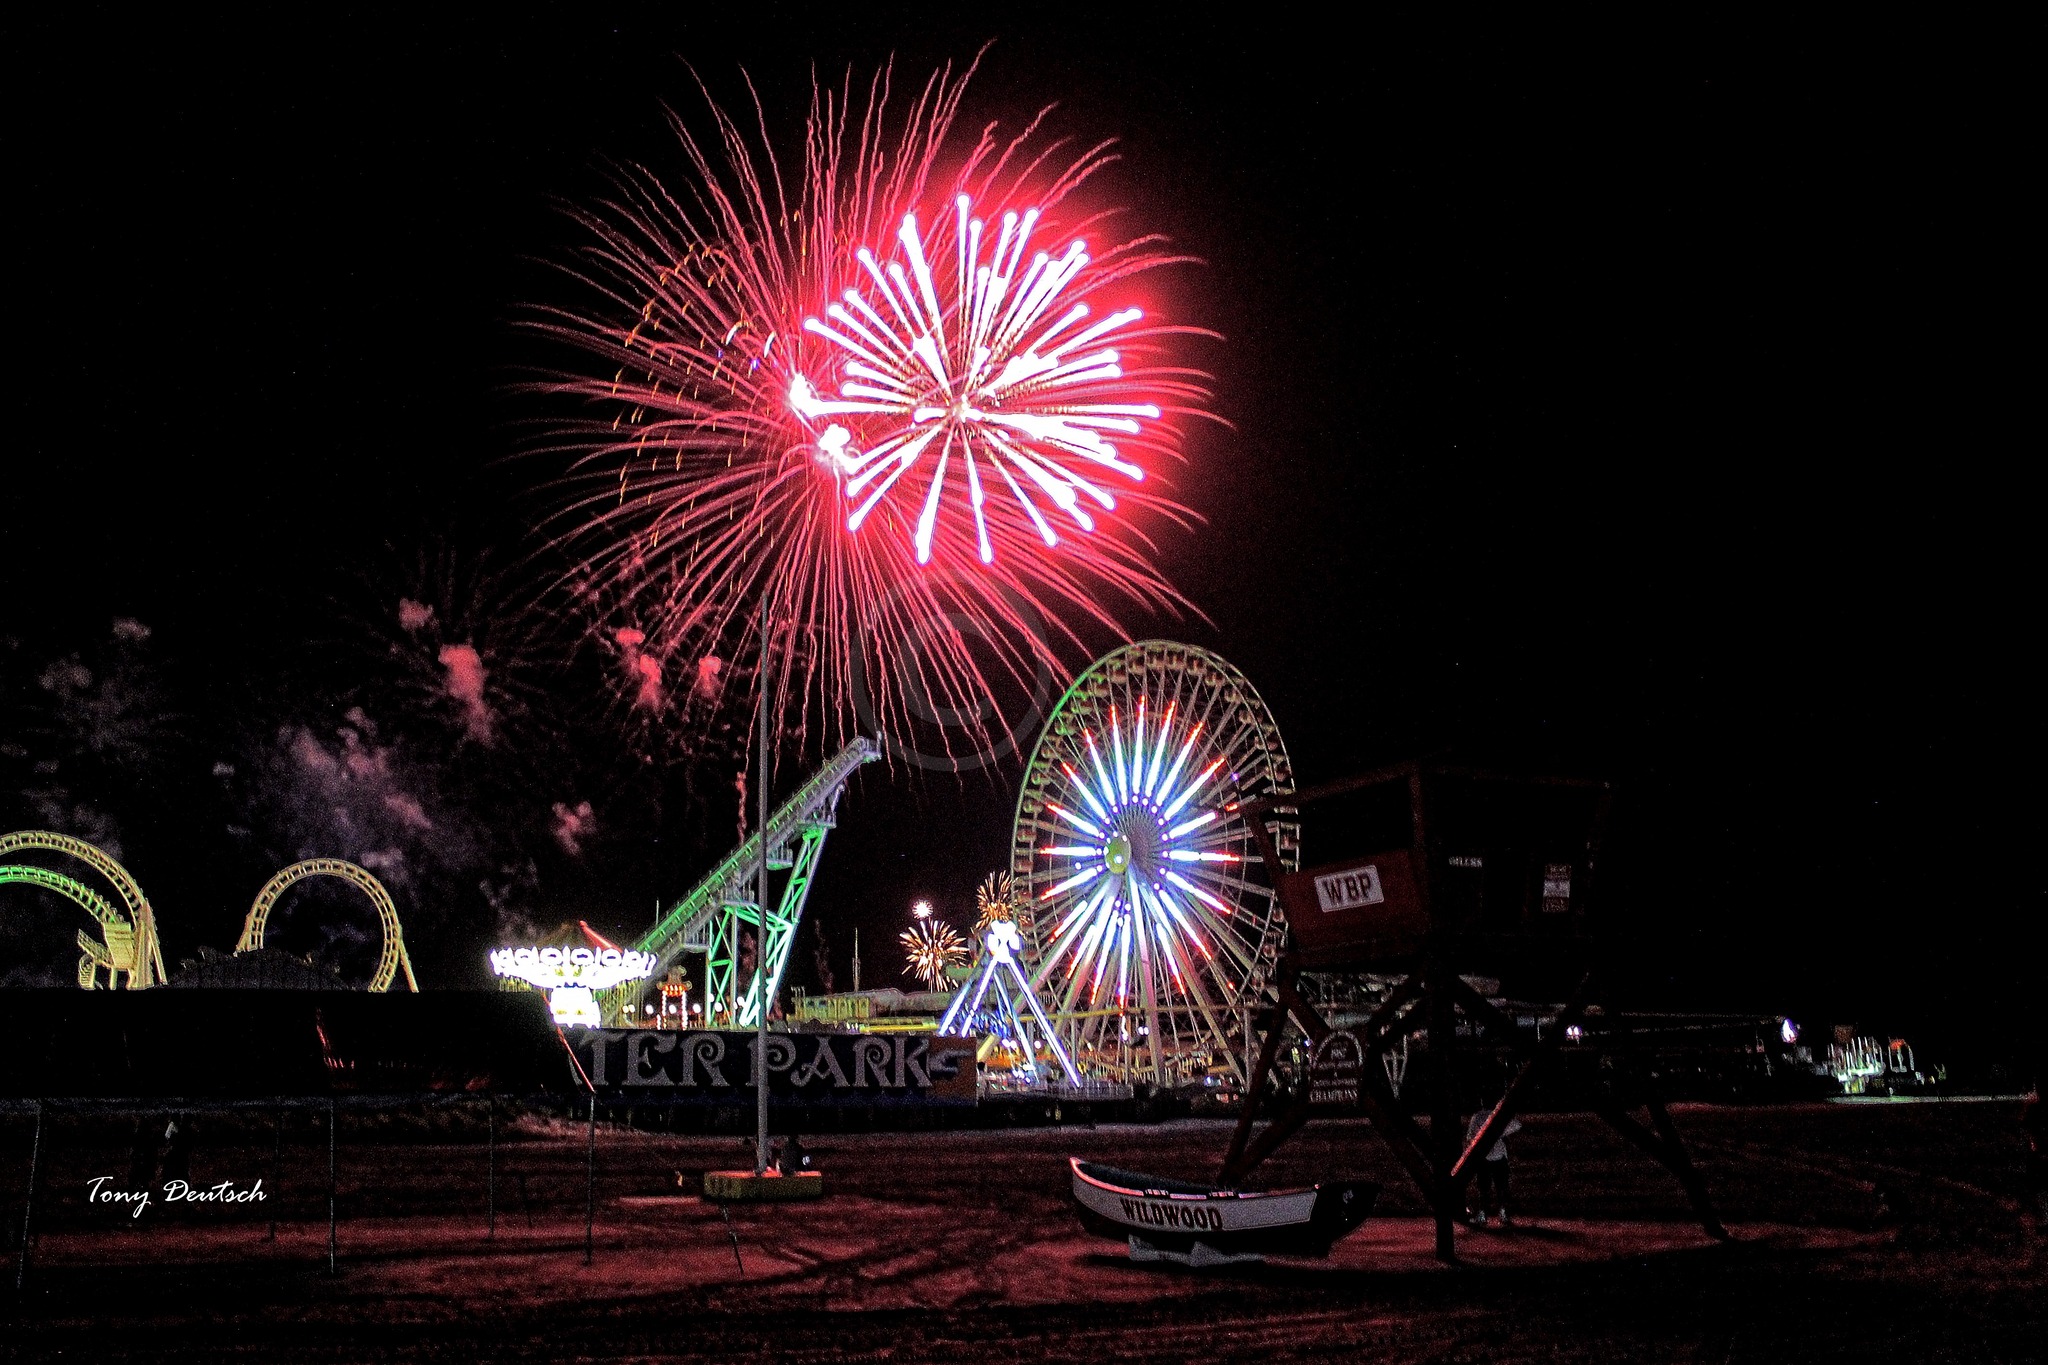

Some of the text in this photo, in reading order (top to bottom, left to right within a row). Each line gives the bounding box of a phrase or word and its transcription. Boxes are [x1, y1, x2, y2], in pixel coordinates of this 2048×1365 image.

[1321, 872, 1371, 906] WBP
[568, 1031, 933, 1088] TER PARK
[1120, 1197, 1223, 1231] WILDWOOD
